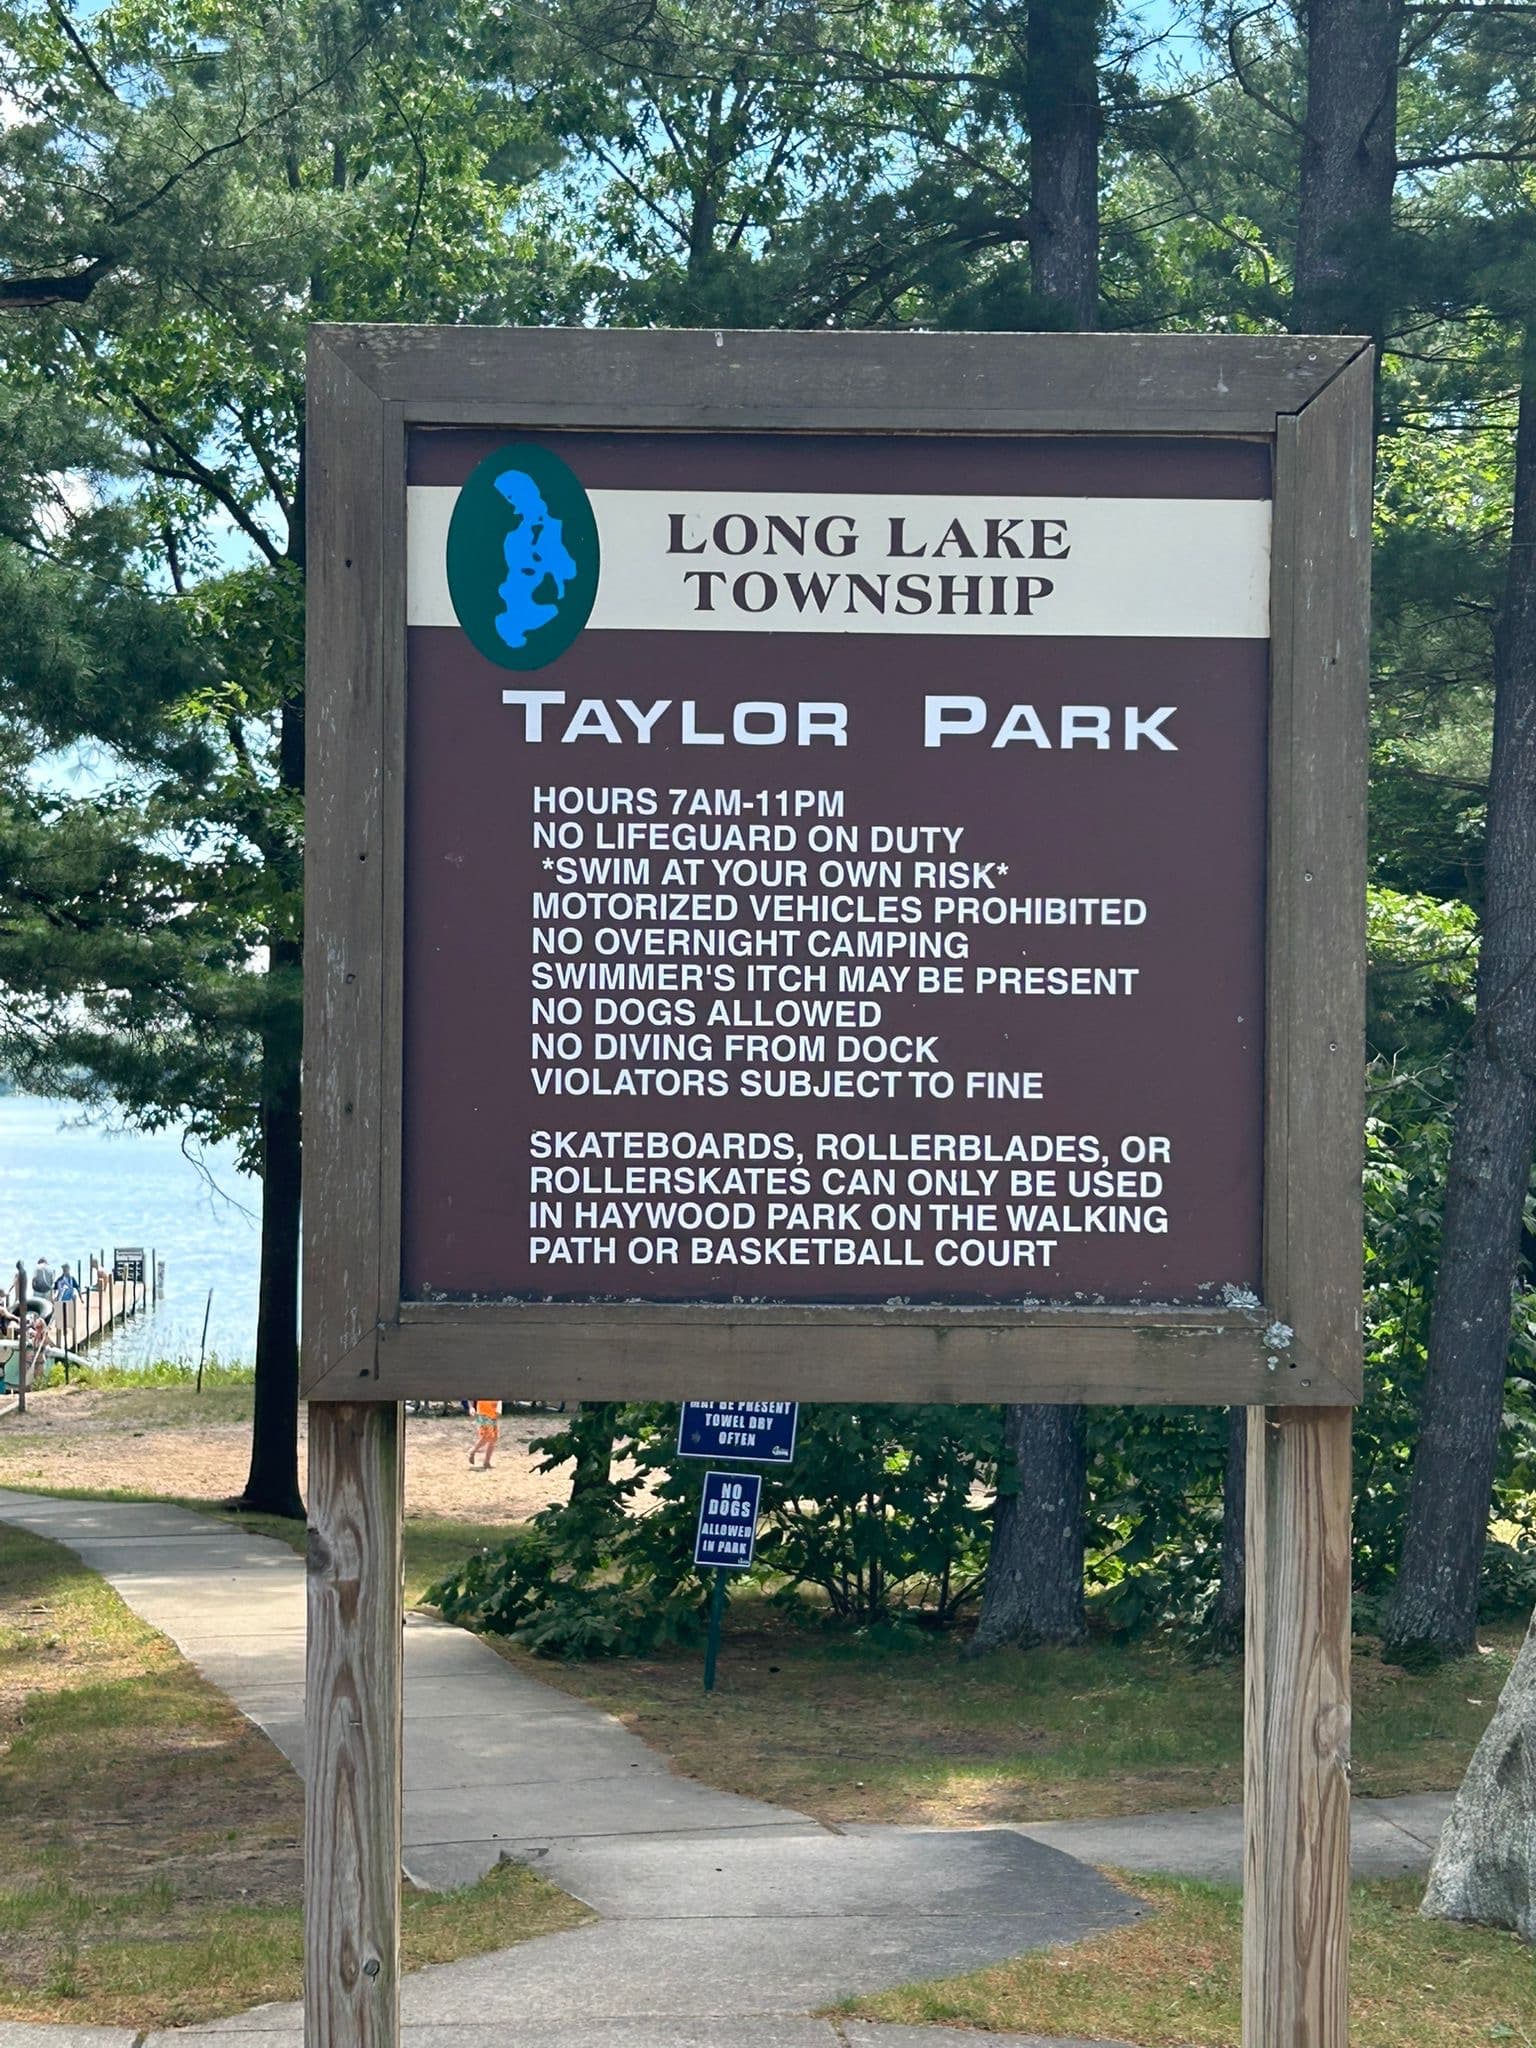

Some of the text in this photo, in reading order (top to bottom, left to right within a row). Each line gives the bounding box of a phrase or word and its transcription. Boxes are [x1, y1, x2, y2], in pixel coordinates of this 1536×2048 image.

[666, 513, 1070, 560] LONG LAKE
[684, 571, 1053, 616] TOWNSHIP
[533, 786, 844, 818] HOURS 7AM-11PM
[533, 821, 965, 854] NO LIFEGUARD ON DUTY
[661, 858, 705, 886] AT
[711, 858, 808, 887] YOUR
[819, 860, 902, 888] OWN
[533, 892, 1147, 926] MOTORIZED VEHICLES PROHIBITED
[532, 927, 969, 959] NO OVERNIGHT CAMPING
[531, 961, 1140, 995] SWIMMER'S ITCH MAY BE PRESENT
[532, 997, 882, 1028] NO DOGS ALLOWED
[532, 1032, 939, 1064] NO DIVING FROM DOCK
[531, 1067, 1044, 1099] VIOLATORS SUBJECT TO FINE
[530, 1130, 1171, 1168] SKATEBOARDS, ROLLERBLADES, OR
[530, 1166, 1163, 1198] ROLLERSKATES CAN ONLY BE USED
[529, 1201, 1168, 1234] IN HAYWOOD PARK ON THE WALKING
[530, 1236, 1058, 1267] PATH OR BASKETBALL COURT
[705, 1413, 774, 1431] TOWEL DRY
[737, 1401, 792, 1415] PRESENT
[718, 1431, 756, 1446] OFTEN
[721, 1482, 742, 1500] NO
[708, 1498, 751, 1517] DOGS
[701, 1522, 752, 1538] ALLOWED
[702, 1539, 747, 1554] IN PARK
